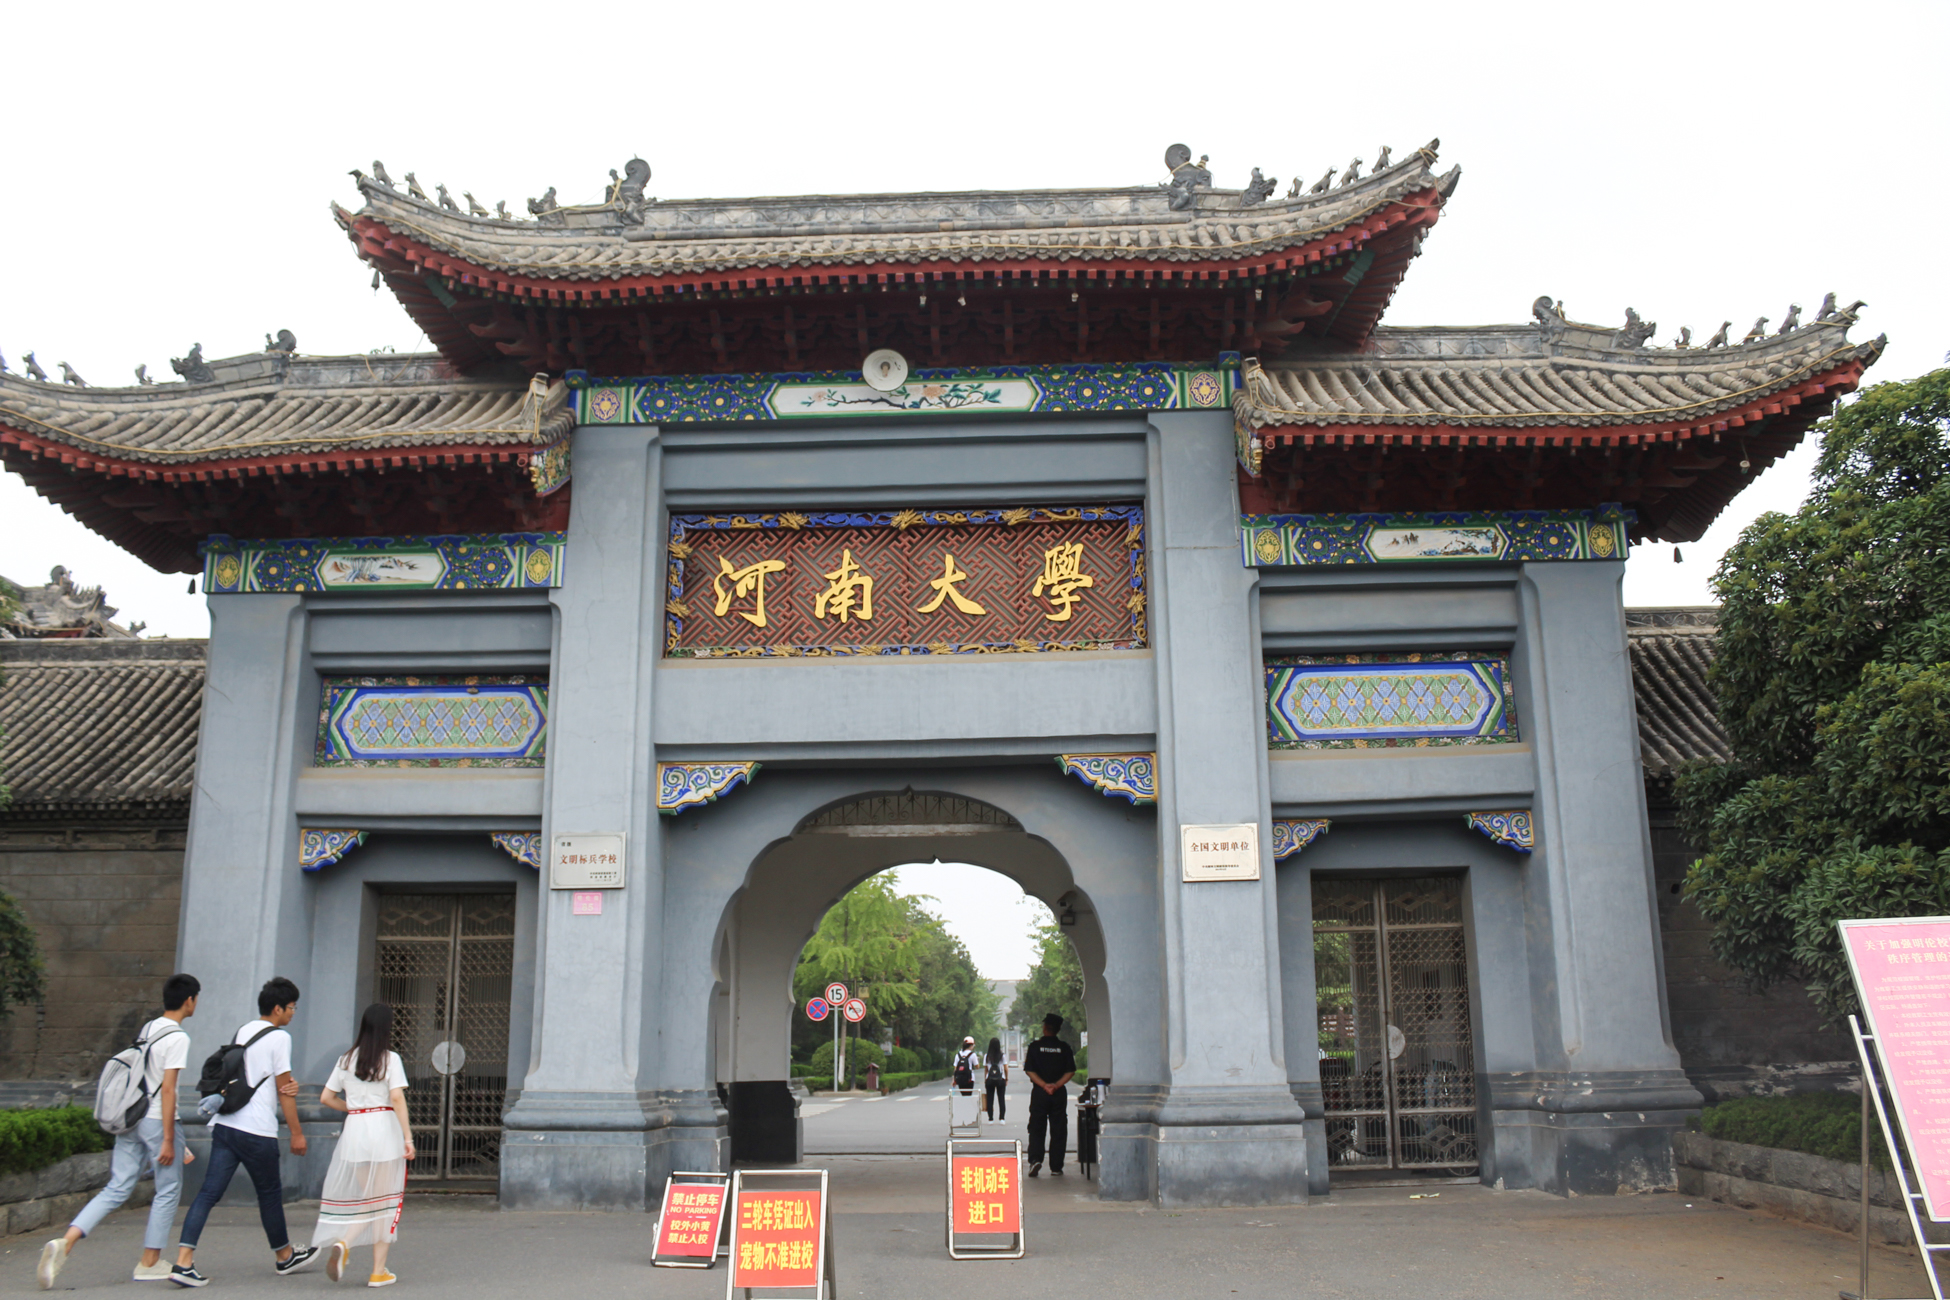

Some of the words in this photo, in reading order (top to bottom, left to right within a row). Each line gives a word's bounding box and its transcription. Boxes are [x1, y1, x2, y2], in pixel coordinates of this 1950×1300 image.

[714, 541, 1093, 628] 河南大學
[1190, 841, 1249, 852] 全国文明单位
[560, 854, 617, 865] 文明标兵学校
[1864, 937, 1950, 951] 关于加强明伦校
[1887, 952, 1950, 964] 秩序管理的
[831, 989, 843, 1001] 15
[961, 1166, 1009, 1194] 非机动车
[672, 1193, 719, 1206] 禁止停车
[741, 1199, 814, 1231] 三轮车凭证出入
[969, 1201, 1004, 1224] 进口
[670, 1220, 711, 1231] 校外小黄
[740, 1241, 814, 1271] 宠物不准进校
